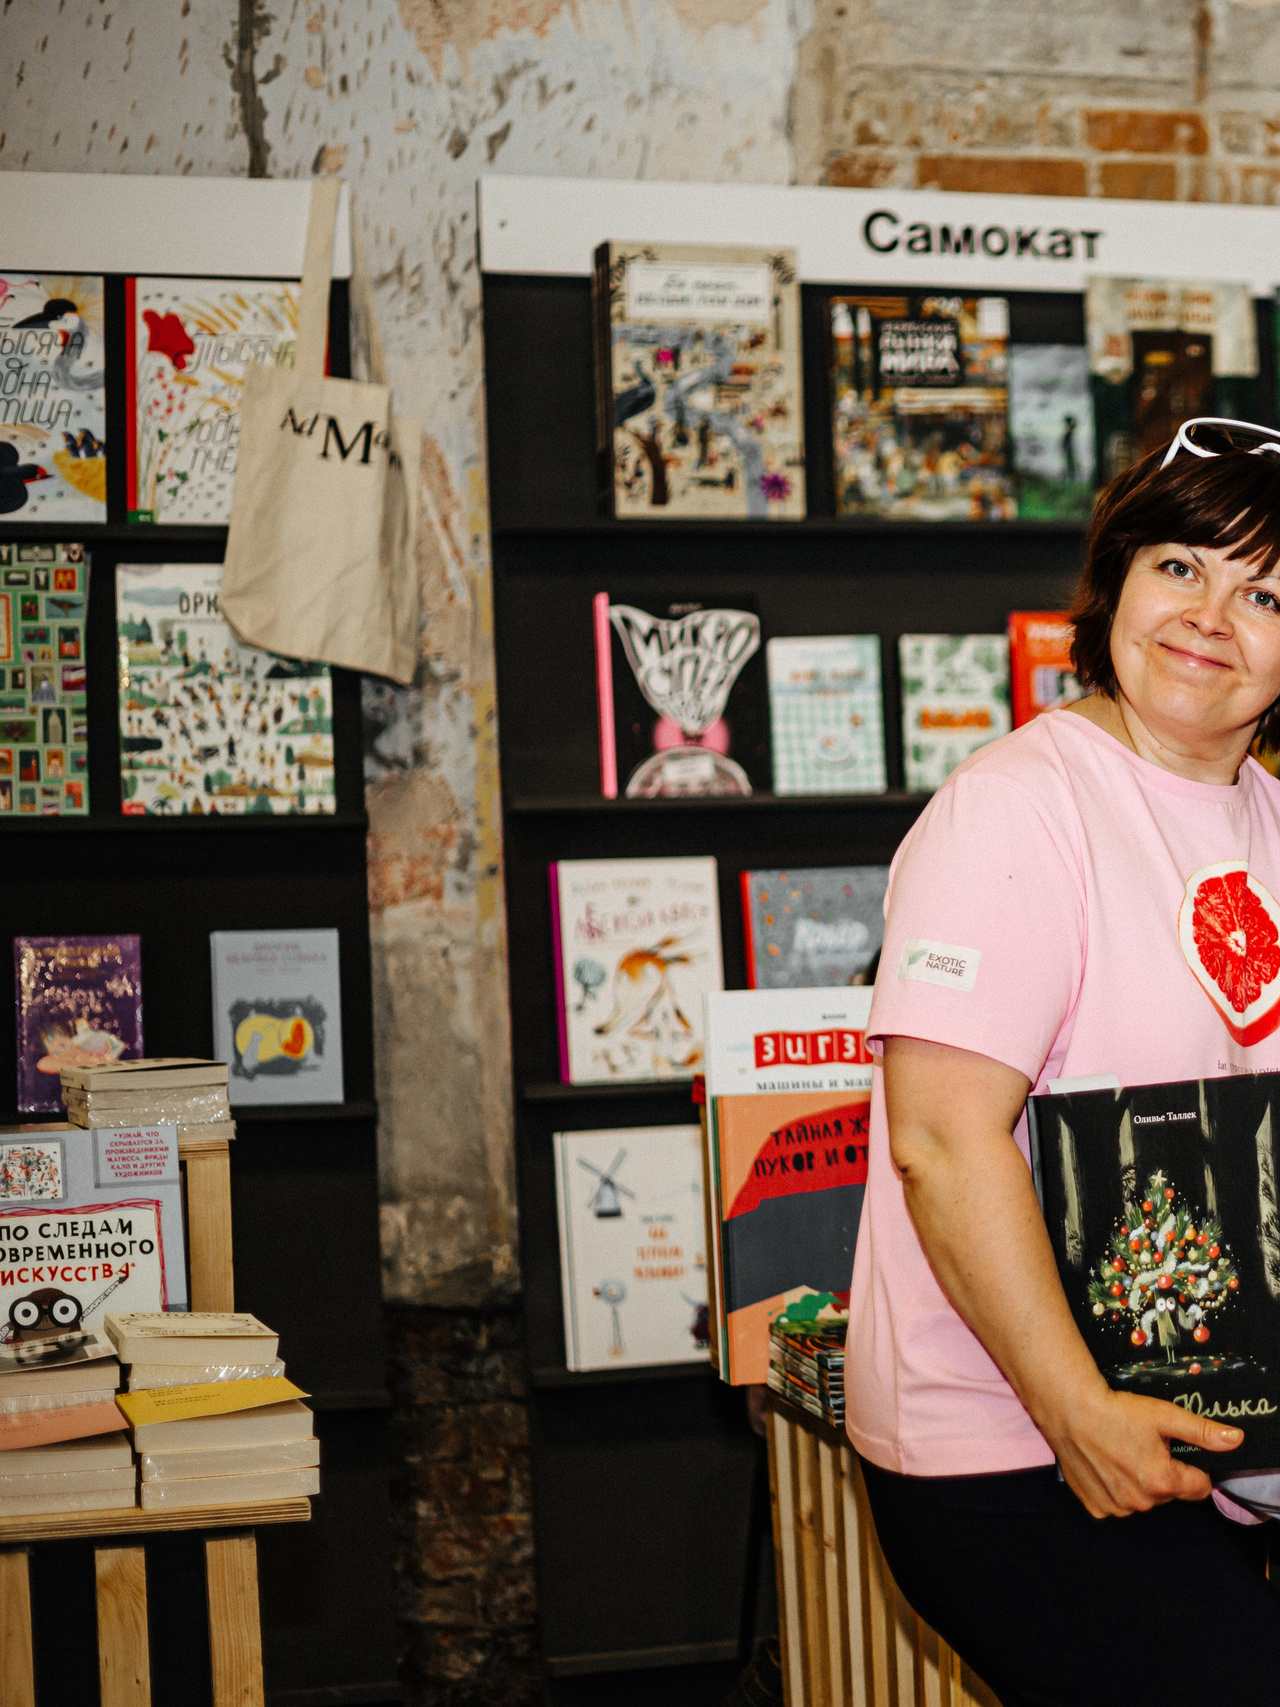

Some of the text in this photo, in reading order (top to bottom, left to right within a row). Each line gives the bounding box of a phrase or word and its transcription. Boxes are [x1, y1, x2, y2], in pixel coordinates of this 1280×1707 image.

[864, 210, 1102, 259] Самокат
[0, 329, 84, 360] ЫСЯЧА
[0, 357, 52, 398] ДНА
[0, 399, 73, 429] ТИЦА
[179, 591, 219, 614] ОРК
[925, 961, 965, 977] NATURE
[928, 953, 967, 969] EXOTIC
[761, 1034, 857, 1063] ЗИГЗ
[1133, 1110, 1198, 1125] Оливье Таллек
[109, 1139, 153, 1148] СКРЫВАЕТСЯ
[770, 1119, 844, 1146] ТАЙНАЯ
[105, 1146, 169, 1156] ПРОИЗВЕДЕНИЯМИ
[110, 1163, 131, 1171] КАЛО
[114, 1169, 163, 1178] ХУДОЖНИКОВ
[0, 1218, 133, 1241] ПО СЛЕДАМ
[0, 1239, 154, 1263] ВРЕМЕННОГО
[1173, 1391, 1278, 1418] Юлька
[1171, 1445, 1202, 1453] АМОКА
